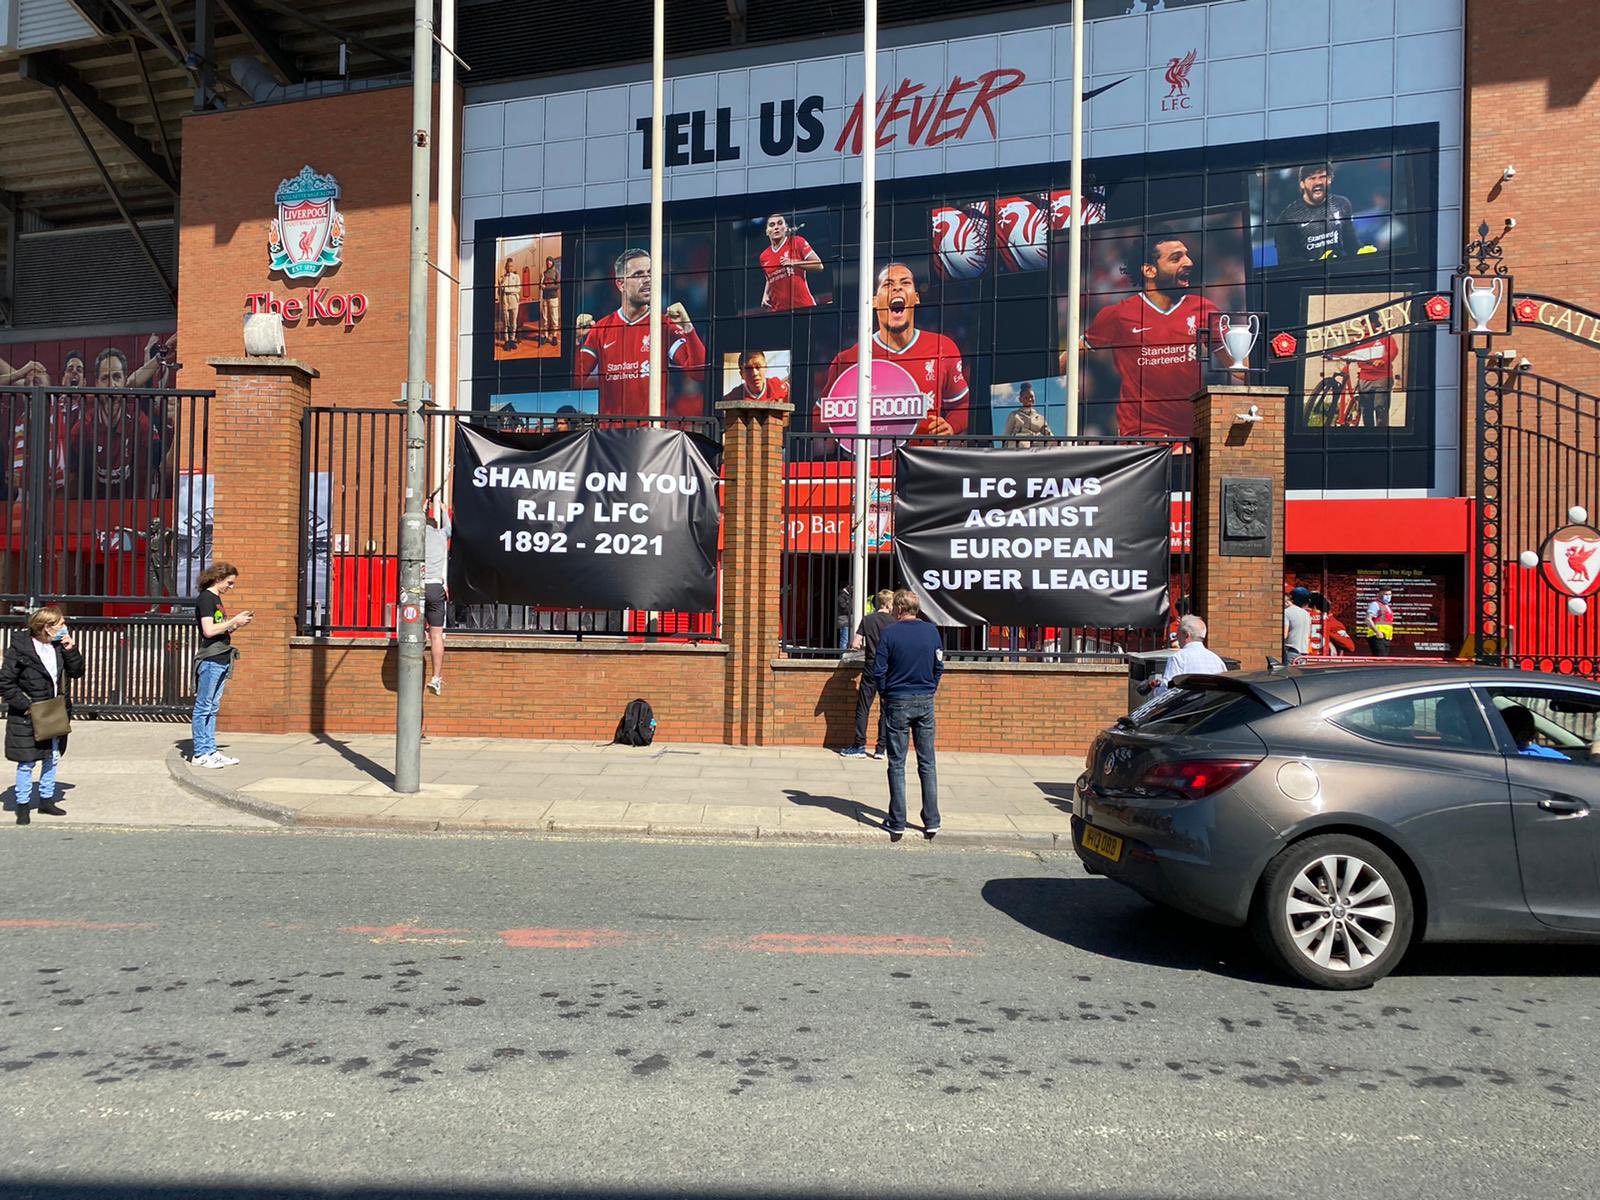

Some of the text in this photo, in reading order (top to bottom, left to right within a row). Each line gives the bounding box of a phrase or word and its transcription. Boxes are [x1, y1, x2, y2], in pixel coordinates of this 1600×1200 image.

[636, 68, 1026, 169] TELL US NEVER
[284, 207, 328, 220] LIVERPOOL
[245, 287, 367, 326] The Kop
[1307, 299, 1412, 351] PAISLEY
[1137, 354, 1186, 366] Chartered
[1141, 344, 1186, 356] Standard
[824, 396, 922, 418] BOO ROOM
[472, 466, 698, 495] SHAME ON YOU
[962, 477, 1101, 498] LFC FANS
[517, 499, 649, 523] R.I.P LFC
[963, 506, 1099, 528] AGAINST
[811, 515, 845, 534] Bar
[499, 530, 568, 553] 1892
[594, 532, 663, 556] 2021
[950, 537, 1114, 559] EUROPEAN
[922, 568, 1148, 590] SUPER LEAGUE
